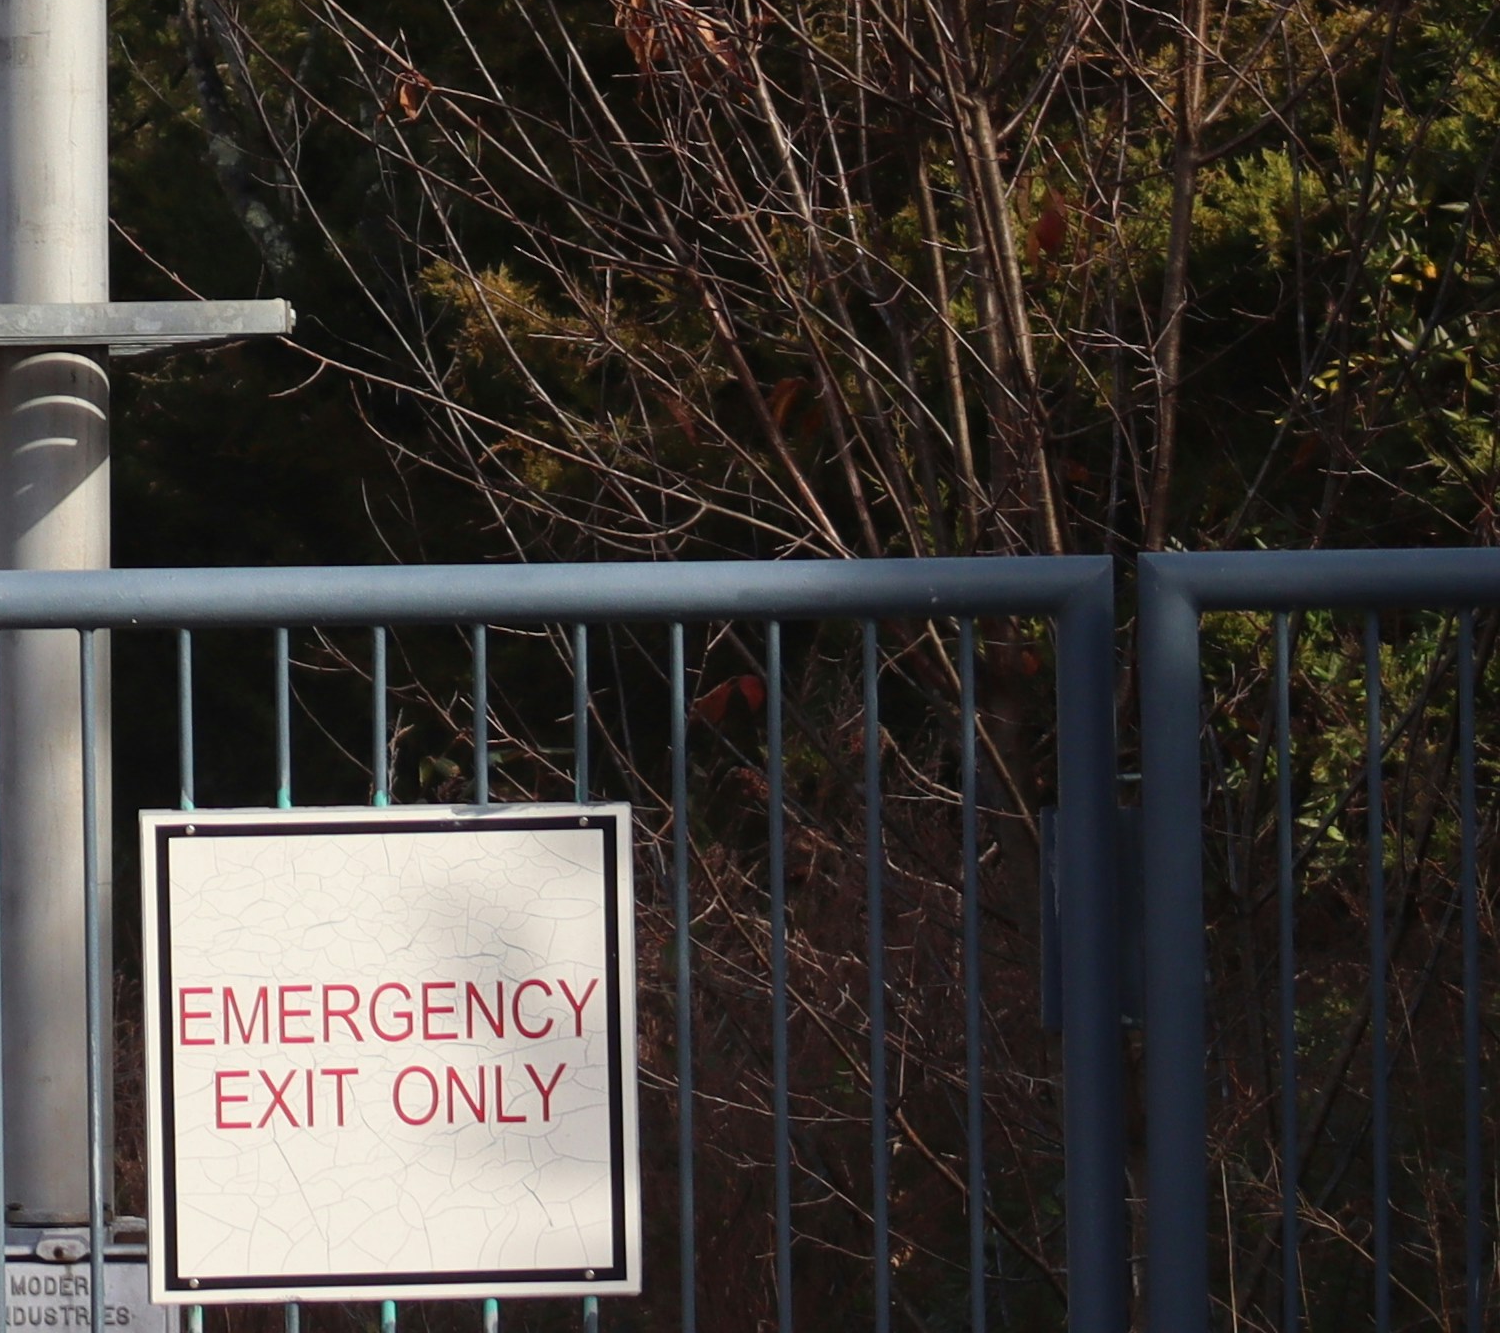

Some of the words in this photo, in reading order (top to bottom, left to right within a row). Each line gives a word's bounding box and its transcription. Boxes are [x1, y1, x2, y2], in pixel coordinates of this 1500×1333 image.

[179, 978, 598, 1046] EMERGENCY
[215, 1067, 360, 1130] EXIT
[393, 1063, 567, 1126] ONLY
[10, 1275, 104, 1296] MODER
